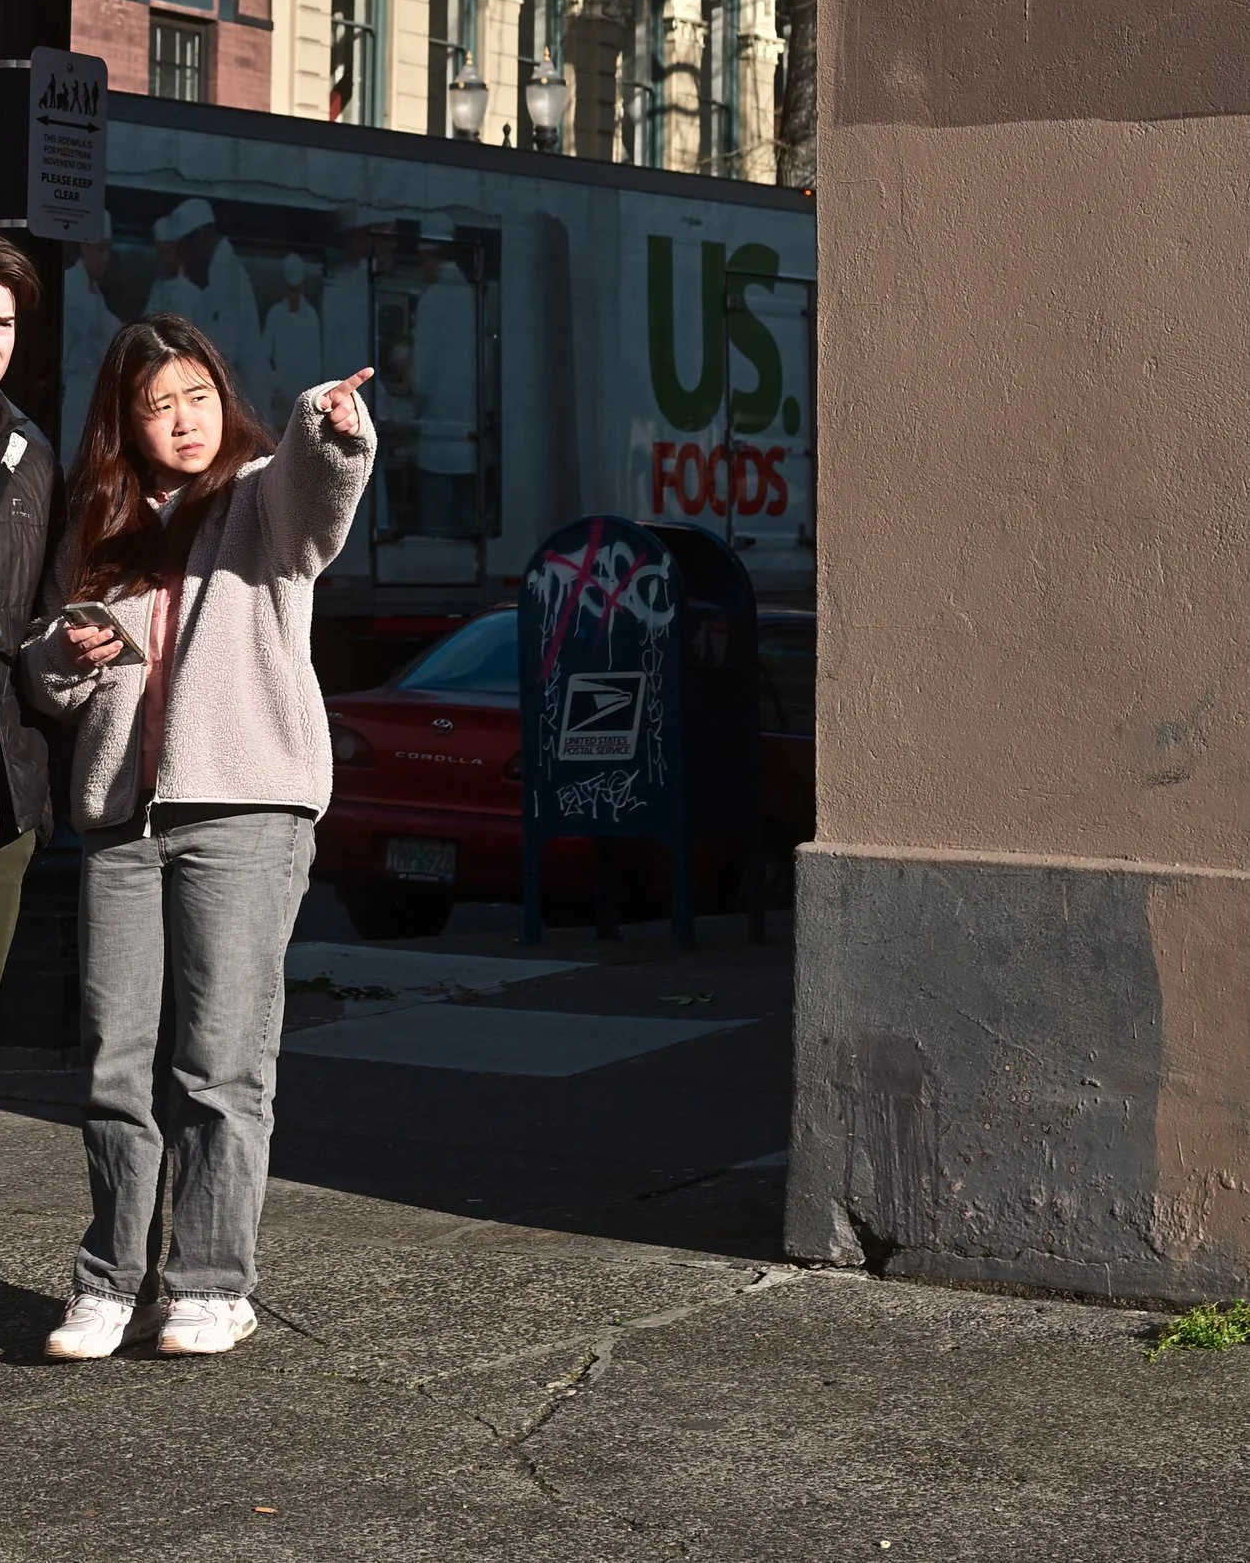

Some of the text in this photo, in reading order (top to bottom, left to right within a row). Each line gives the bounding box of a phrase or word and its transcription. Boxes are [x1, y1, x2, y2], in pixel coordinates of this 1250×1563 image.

[41, 172, 93, 189] PLEASE KEEP
[53, 189, 80, 202] CLEAR
[652, 441, 789, 518] FOODS
[565, 736, 628, 746] UNITED STATES
[563, 745, 630, 756] POSTAL SERVICE
[395, 751, 483, 766] COROLLA
